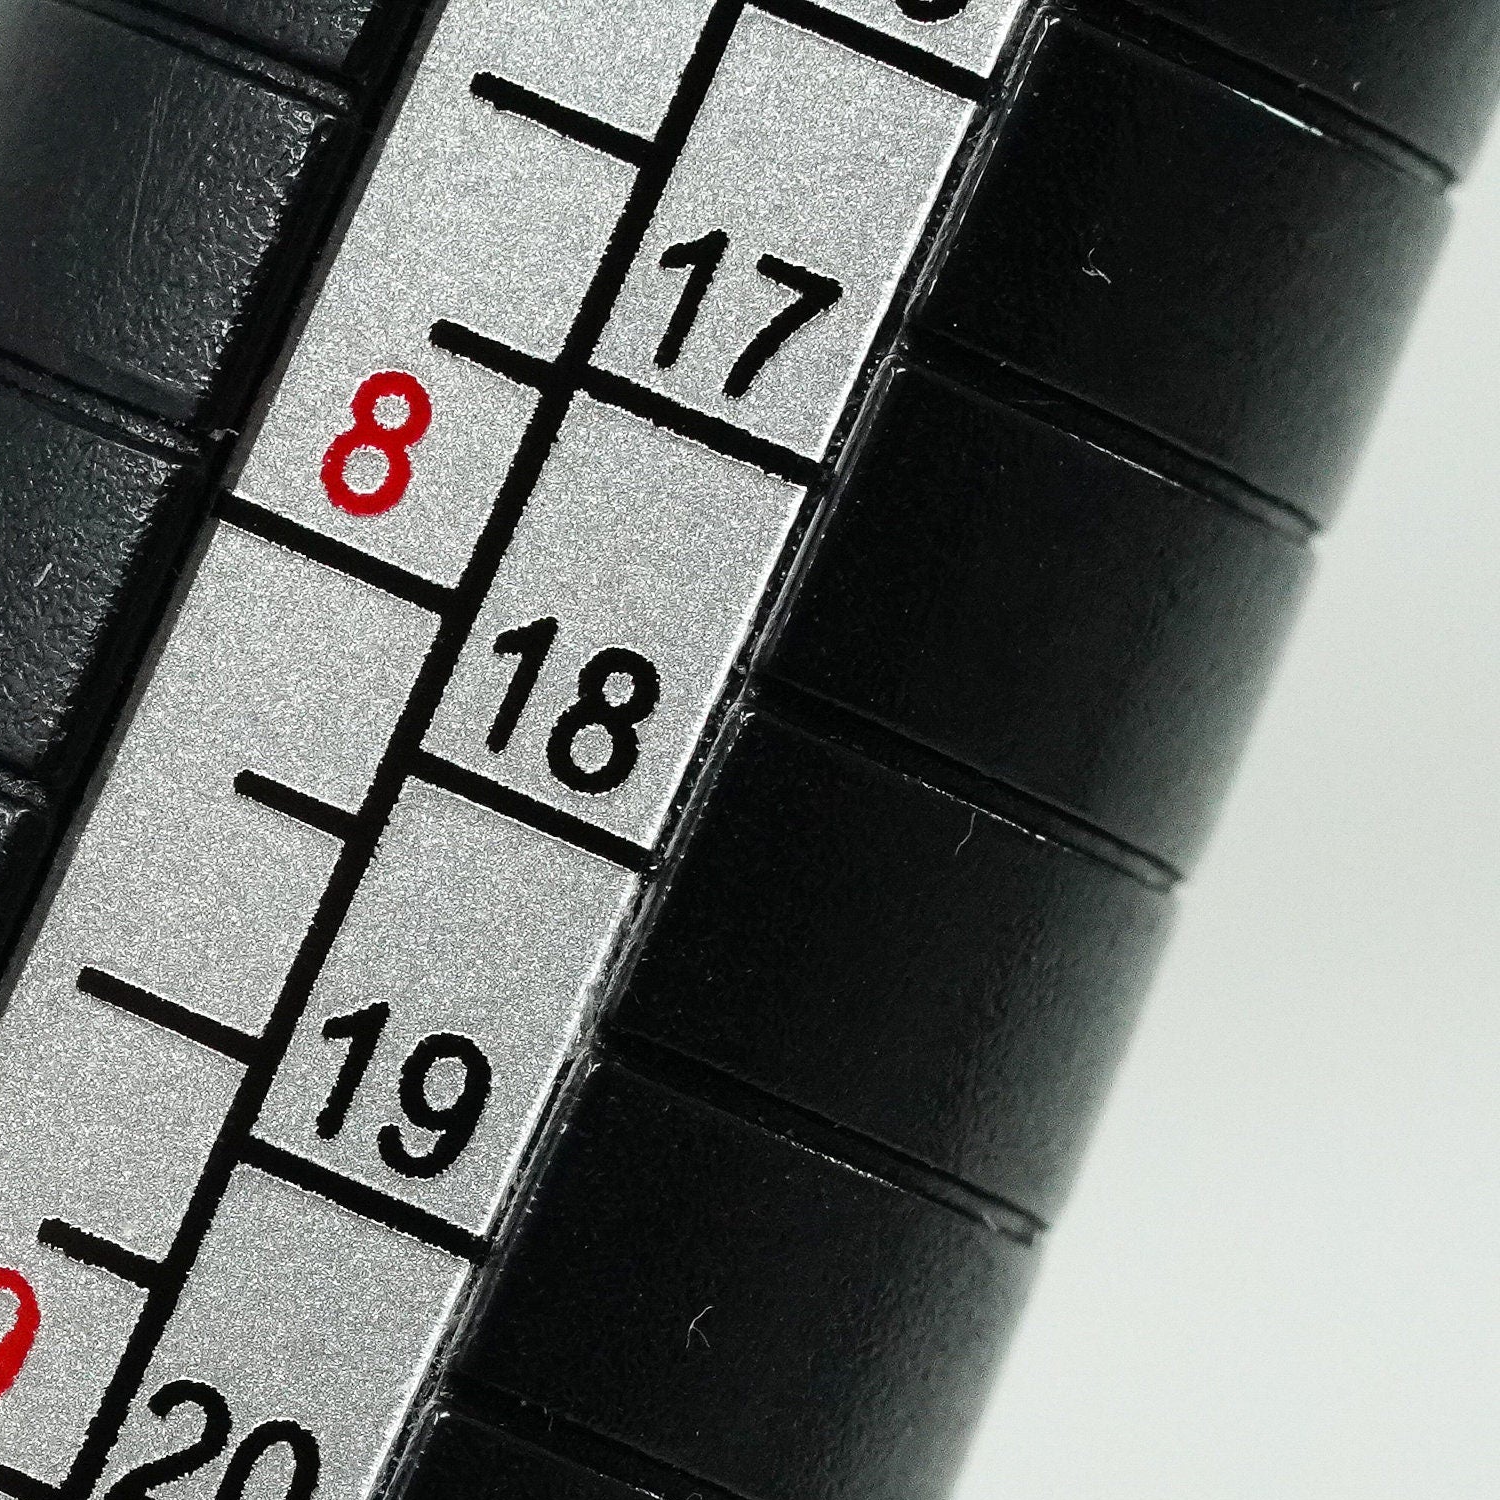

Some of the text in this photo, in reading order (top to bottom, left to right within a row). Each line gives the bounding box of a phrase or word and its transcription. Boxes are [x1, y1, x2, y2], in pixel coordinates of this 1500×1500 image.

[653, 228, 843, 400] 17
[319, 370, 433, 518] 8
[485, 616, 661, 796] 18
[315, 1001, 492, 1180] 19
